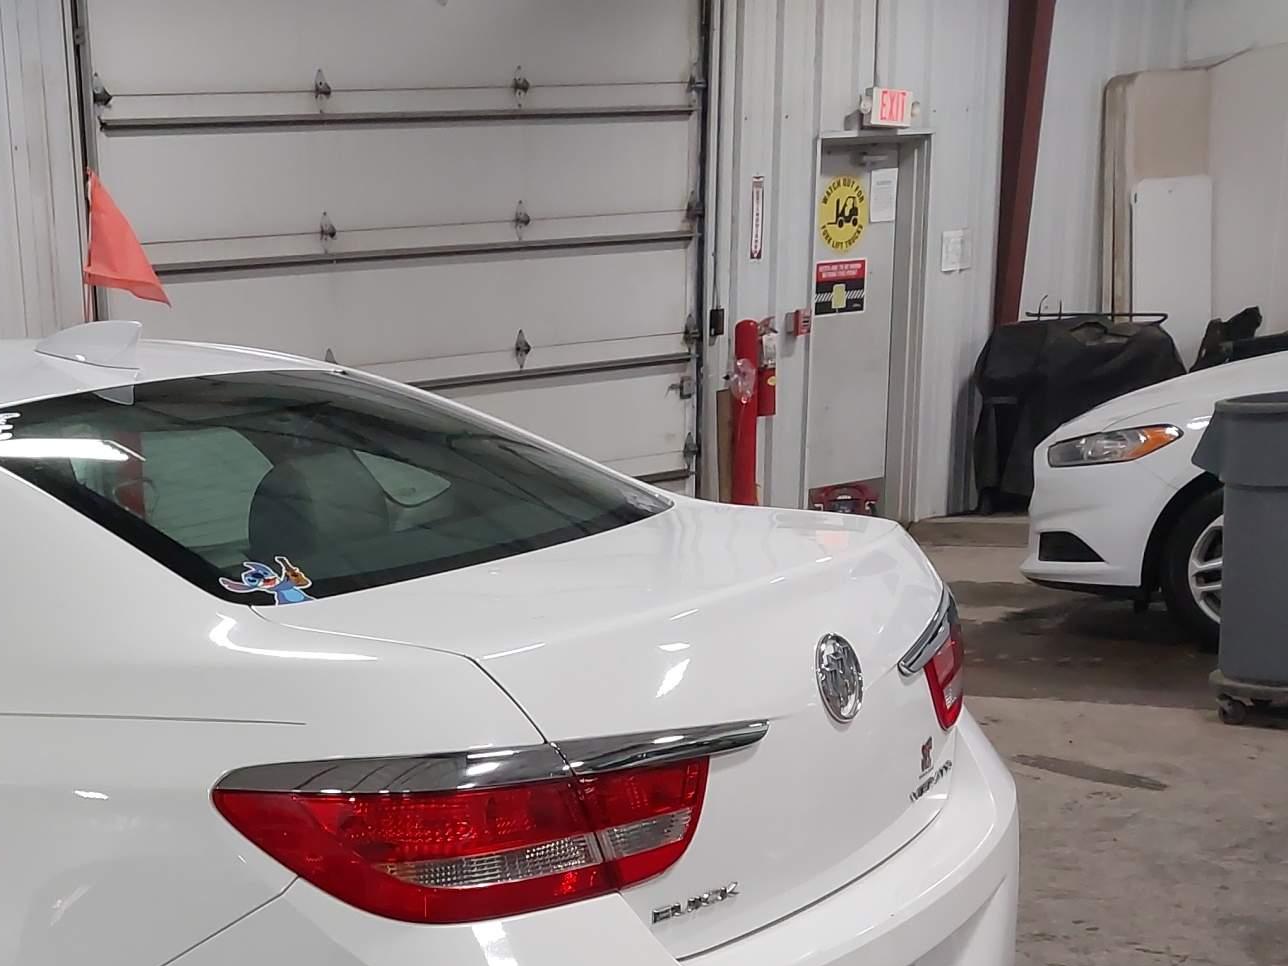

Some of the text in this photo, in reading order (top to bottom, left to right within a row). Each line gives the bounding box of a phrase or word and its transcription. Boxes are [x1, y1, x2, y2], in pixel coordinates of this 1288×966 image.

[880, 90, 907, 122] EXIT
[822, 179, 841, 205] WATCH
[842, 178, 855, 188] OUT
[854, 185, 864, 203] FOR
[832, 241, 844, 250] LIFT
[651, 881, 740, 924] BUICK
